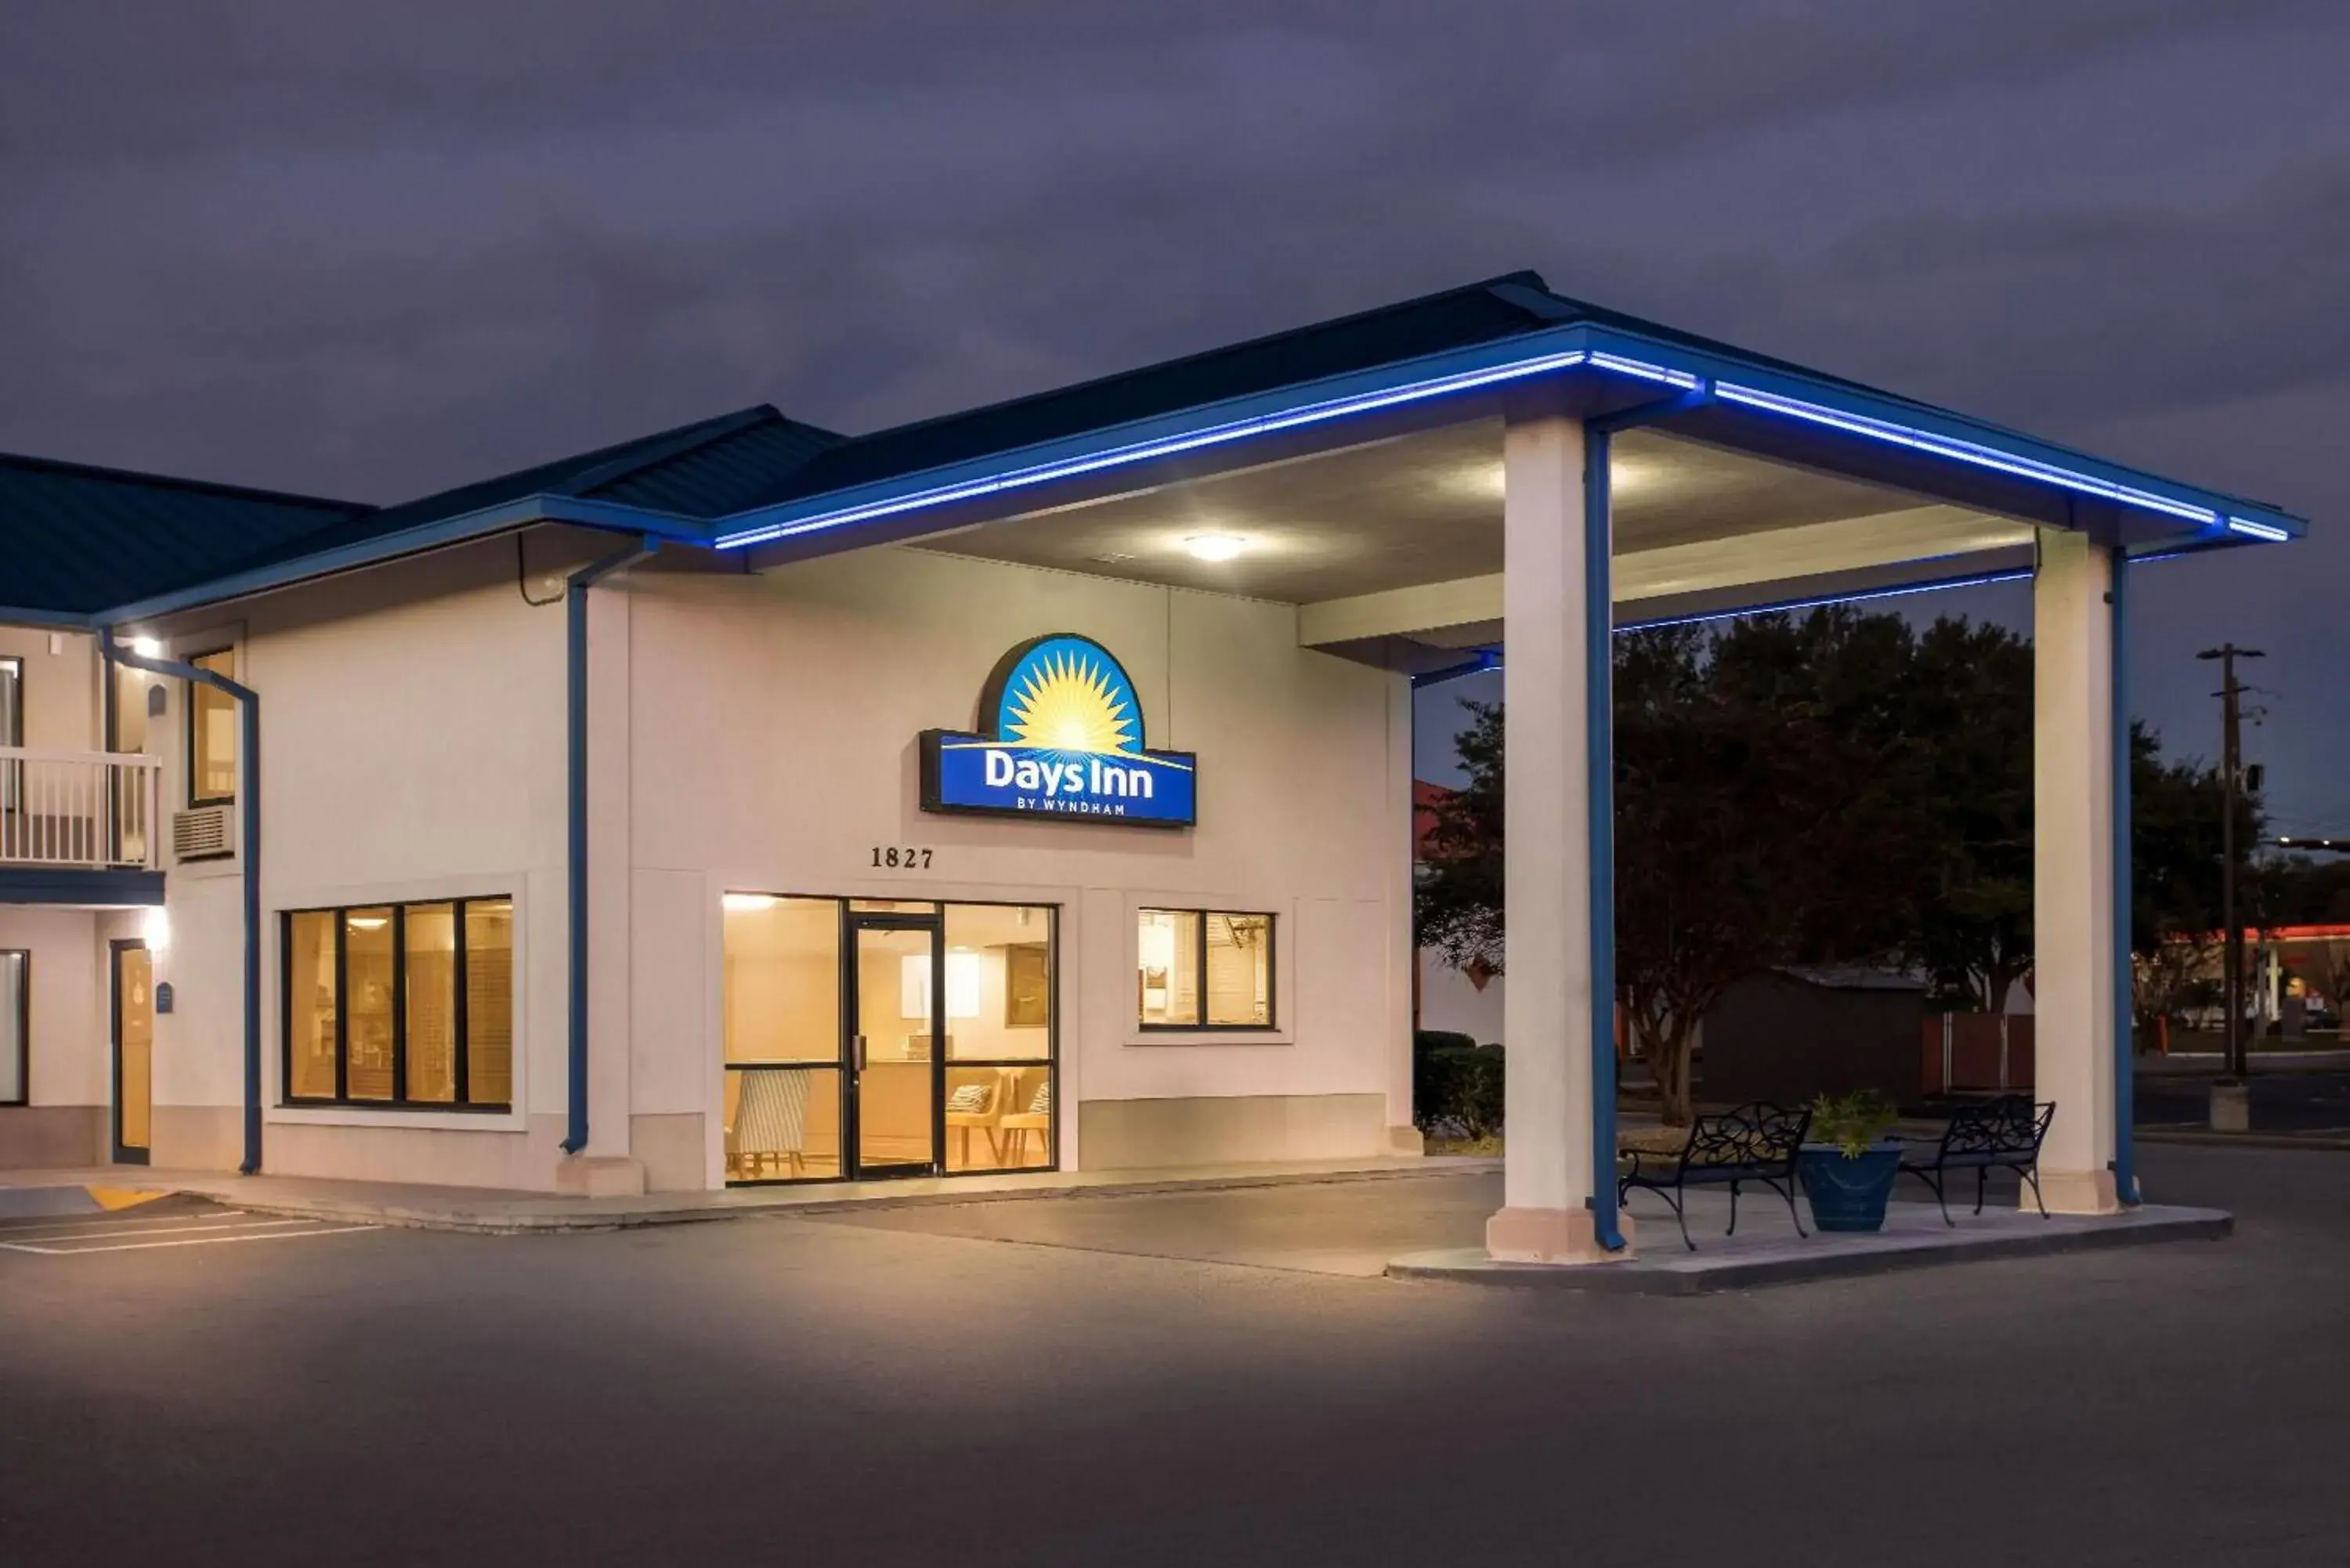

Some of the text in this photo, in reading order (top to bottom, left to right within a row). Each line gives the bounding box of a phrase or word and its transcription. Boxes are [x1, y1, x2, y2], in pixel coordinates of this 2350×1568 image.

[985, 750, 1153, 798] Days Inn
[1018, 797, 1125, 815] BY WYNDHAM
[871, 847, 933, 869] 1827
